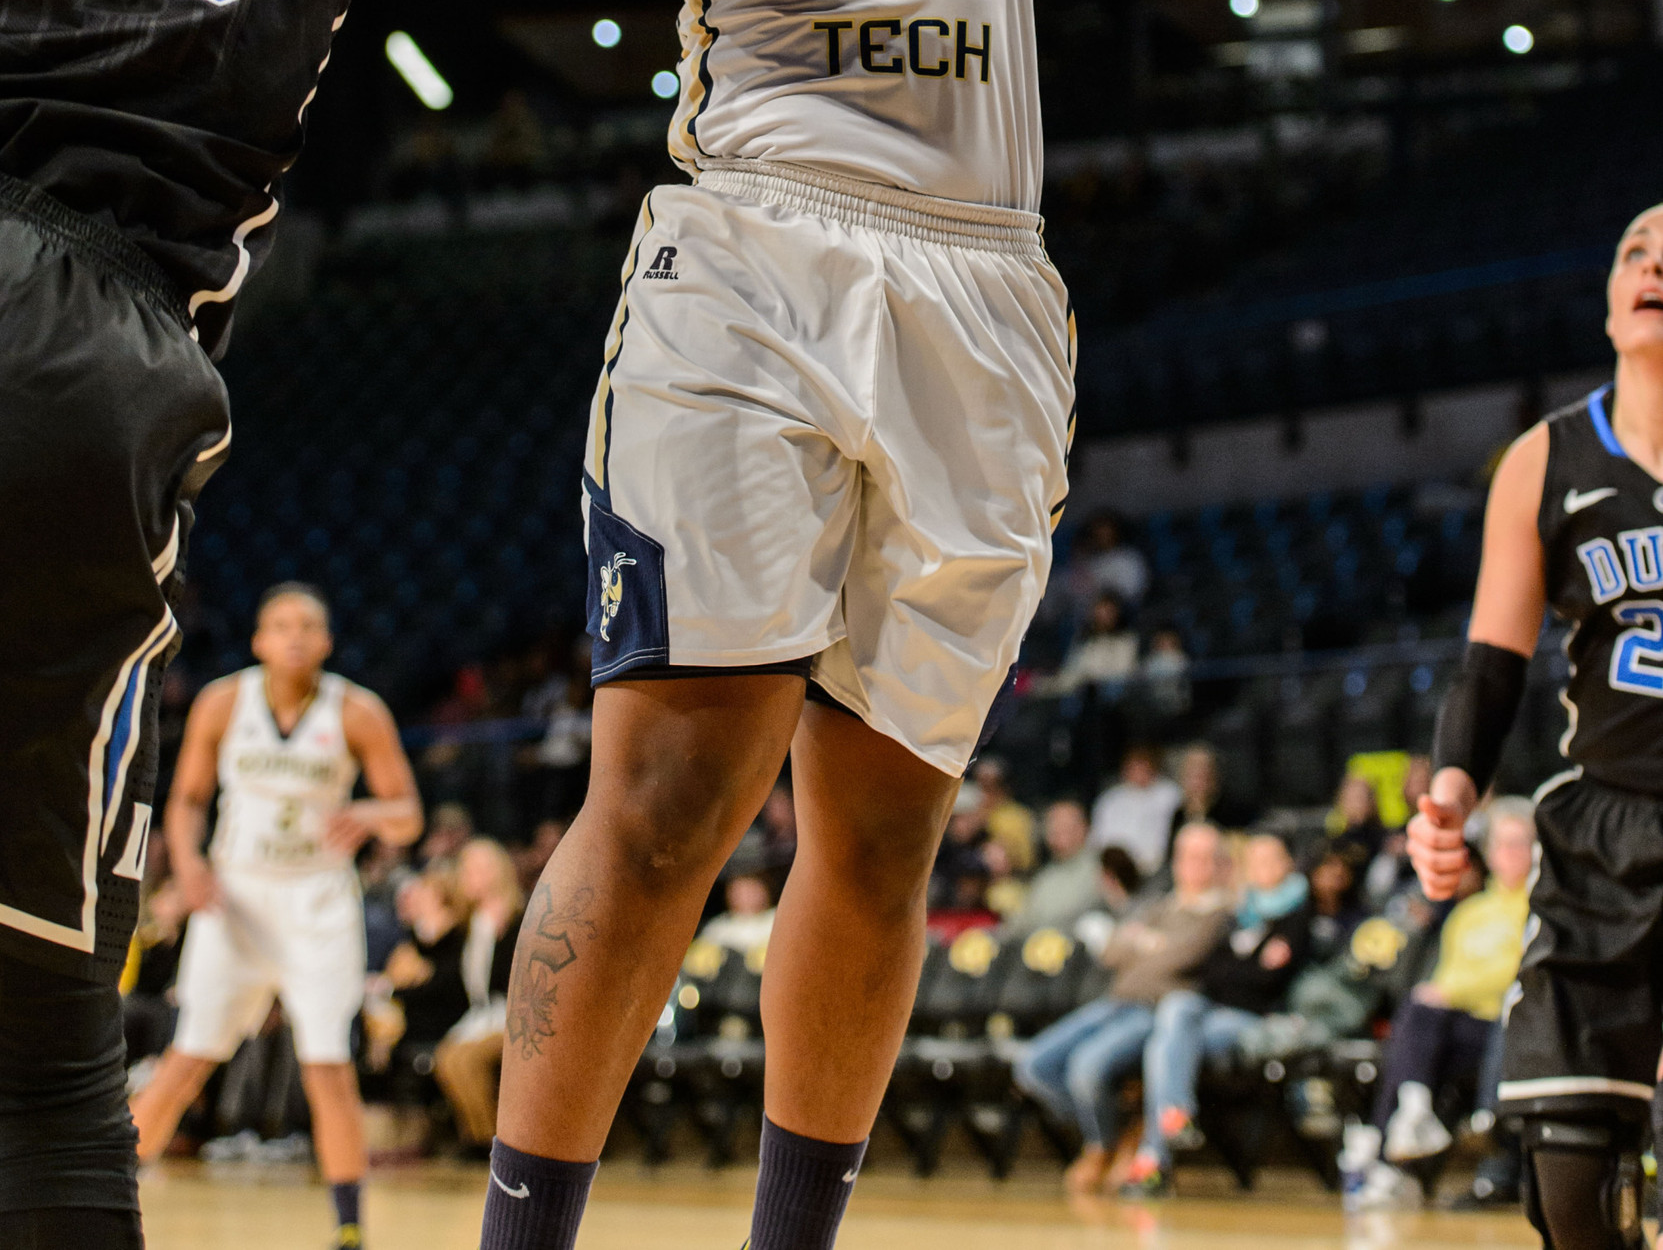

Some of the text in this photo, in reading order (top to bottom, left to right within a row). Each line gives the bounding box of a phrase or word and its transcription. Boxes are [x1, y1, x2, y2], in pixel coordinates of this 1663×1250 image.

[810, 17, 992, 85] TECH
[650, 246, 678, 270] R
[643, 271, 679, 280] RUSSELL
